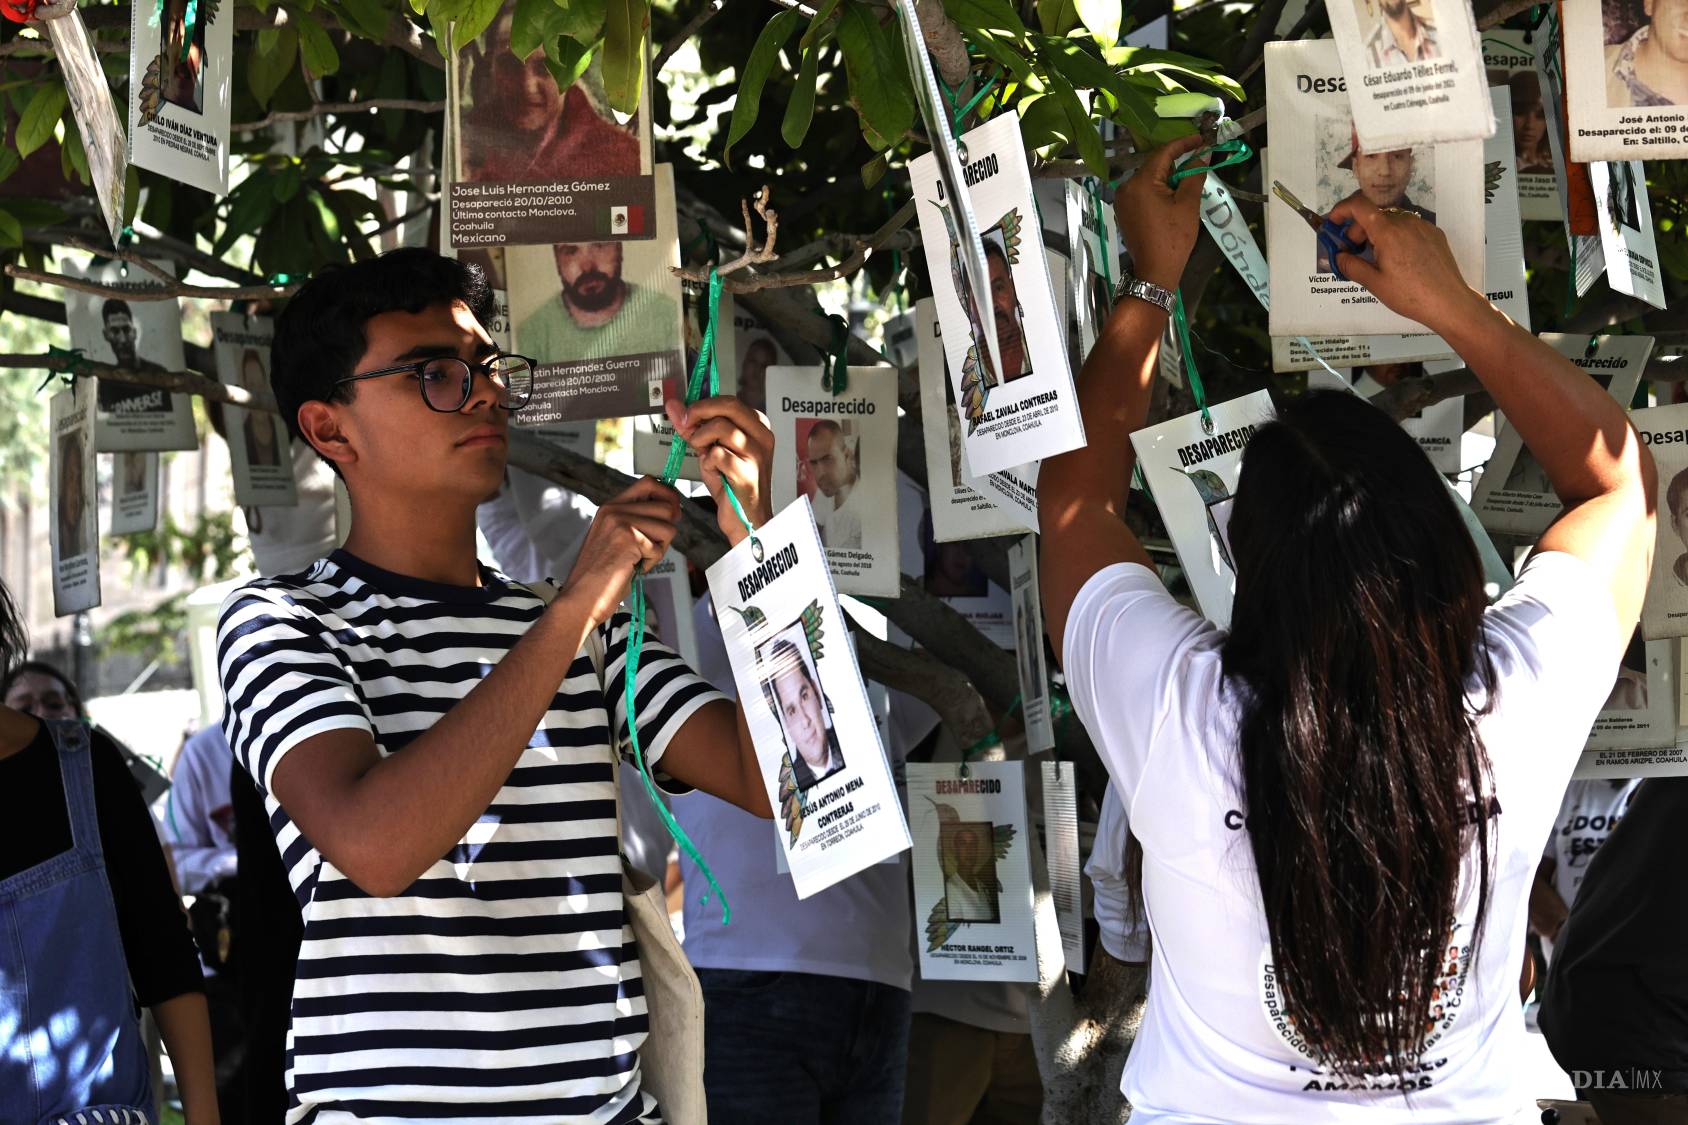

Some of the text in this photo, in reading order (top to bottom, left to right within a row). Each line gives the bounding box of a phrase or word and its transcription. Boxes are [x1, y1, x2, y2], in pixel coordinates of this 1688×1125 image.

[1619, 114, 1685, 124] José Antonio
[1578, 125, 1646, 138] Desaparecido
[1623, 136, 1680, 146] En: Saltillo,
[452, 180, 611, 197] Jose Luis Hernandez Gómez
[452, 196, 573, 209] Desapareció 20/10/2010
[452, 210, 484, 220] Último
[485, 209, 527, 218] contacto
[452, 222, 495, 231] Coahuila
[452, 234, 507, 243] Mexicano
[1308, 275, 1331, 283] Víctor
[1311, 285, 1358, 295] Desaparecido
[1351, 295, 1379, 304] Saltillo,
[1486, 291, 1514, 301] TEGUI
[552, 361, 604, 378] Hernandez
[605, 359, 641, 371] Guerra
[566, 373, 616, 385] 20/10/2010
[543, 387, 579, 399] contacto
[782, 397, 876, 416] Desaparecido
[995, 403, 1020, 419] ZAVALA
[1020, 390, 1058, 411] CONTRERAS
[517, 413, 562, 424] Mexicano
[738, 542, 799, 603] DESAPARECIDO
[1627, 750, 1658, 758] FEBRERO
[1606, 758, 1630, 766] RAMOS
[935, 779, 1002, 794] DESAPARECIDO
[818, 786, 846, 810] ANTONIO
[845, 776, 864, 794] MENA
[817, 801, 854, 829] CONTRERAS
[994, 946, 1014, 954] ORTIZ
